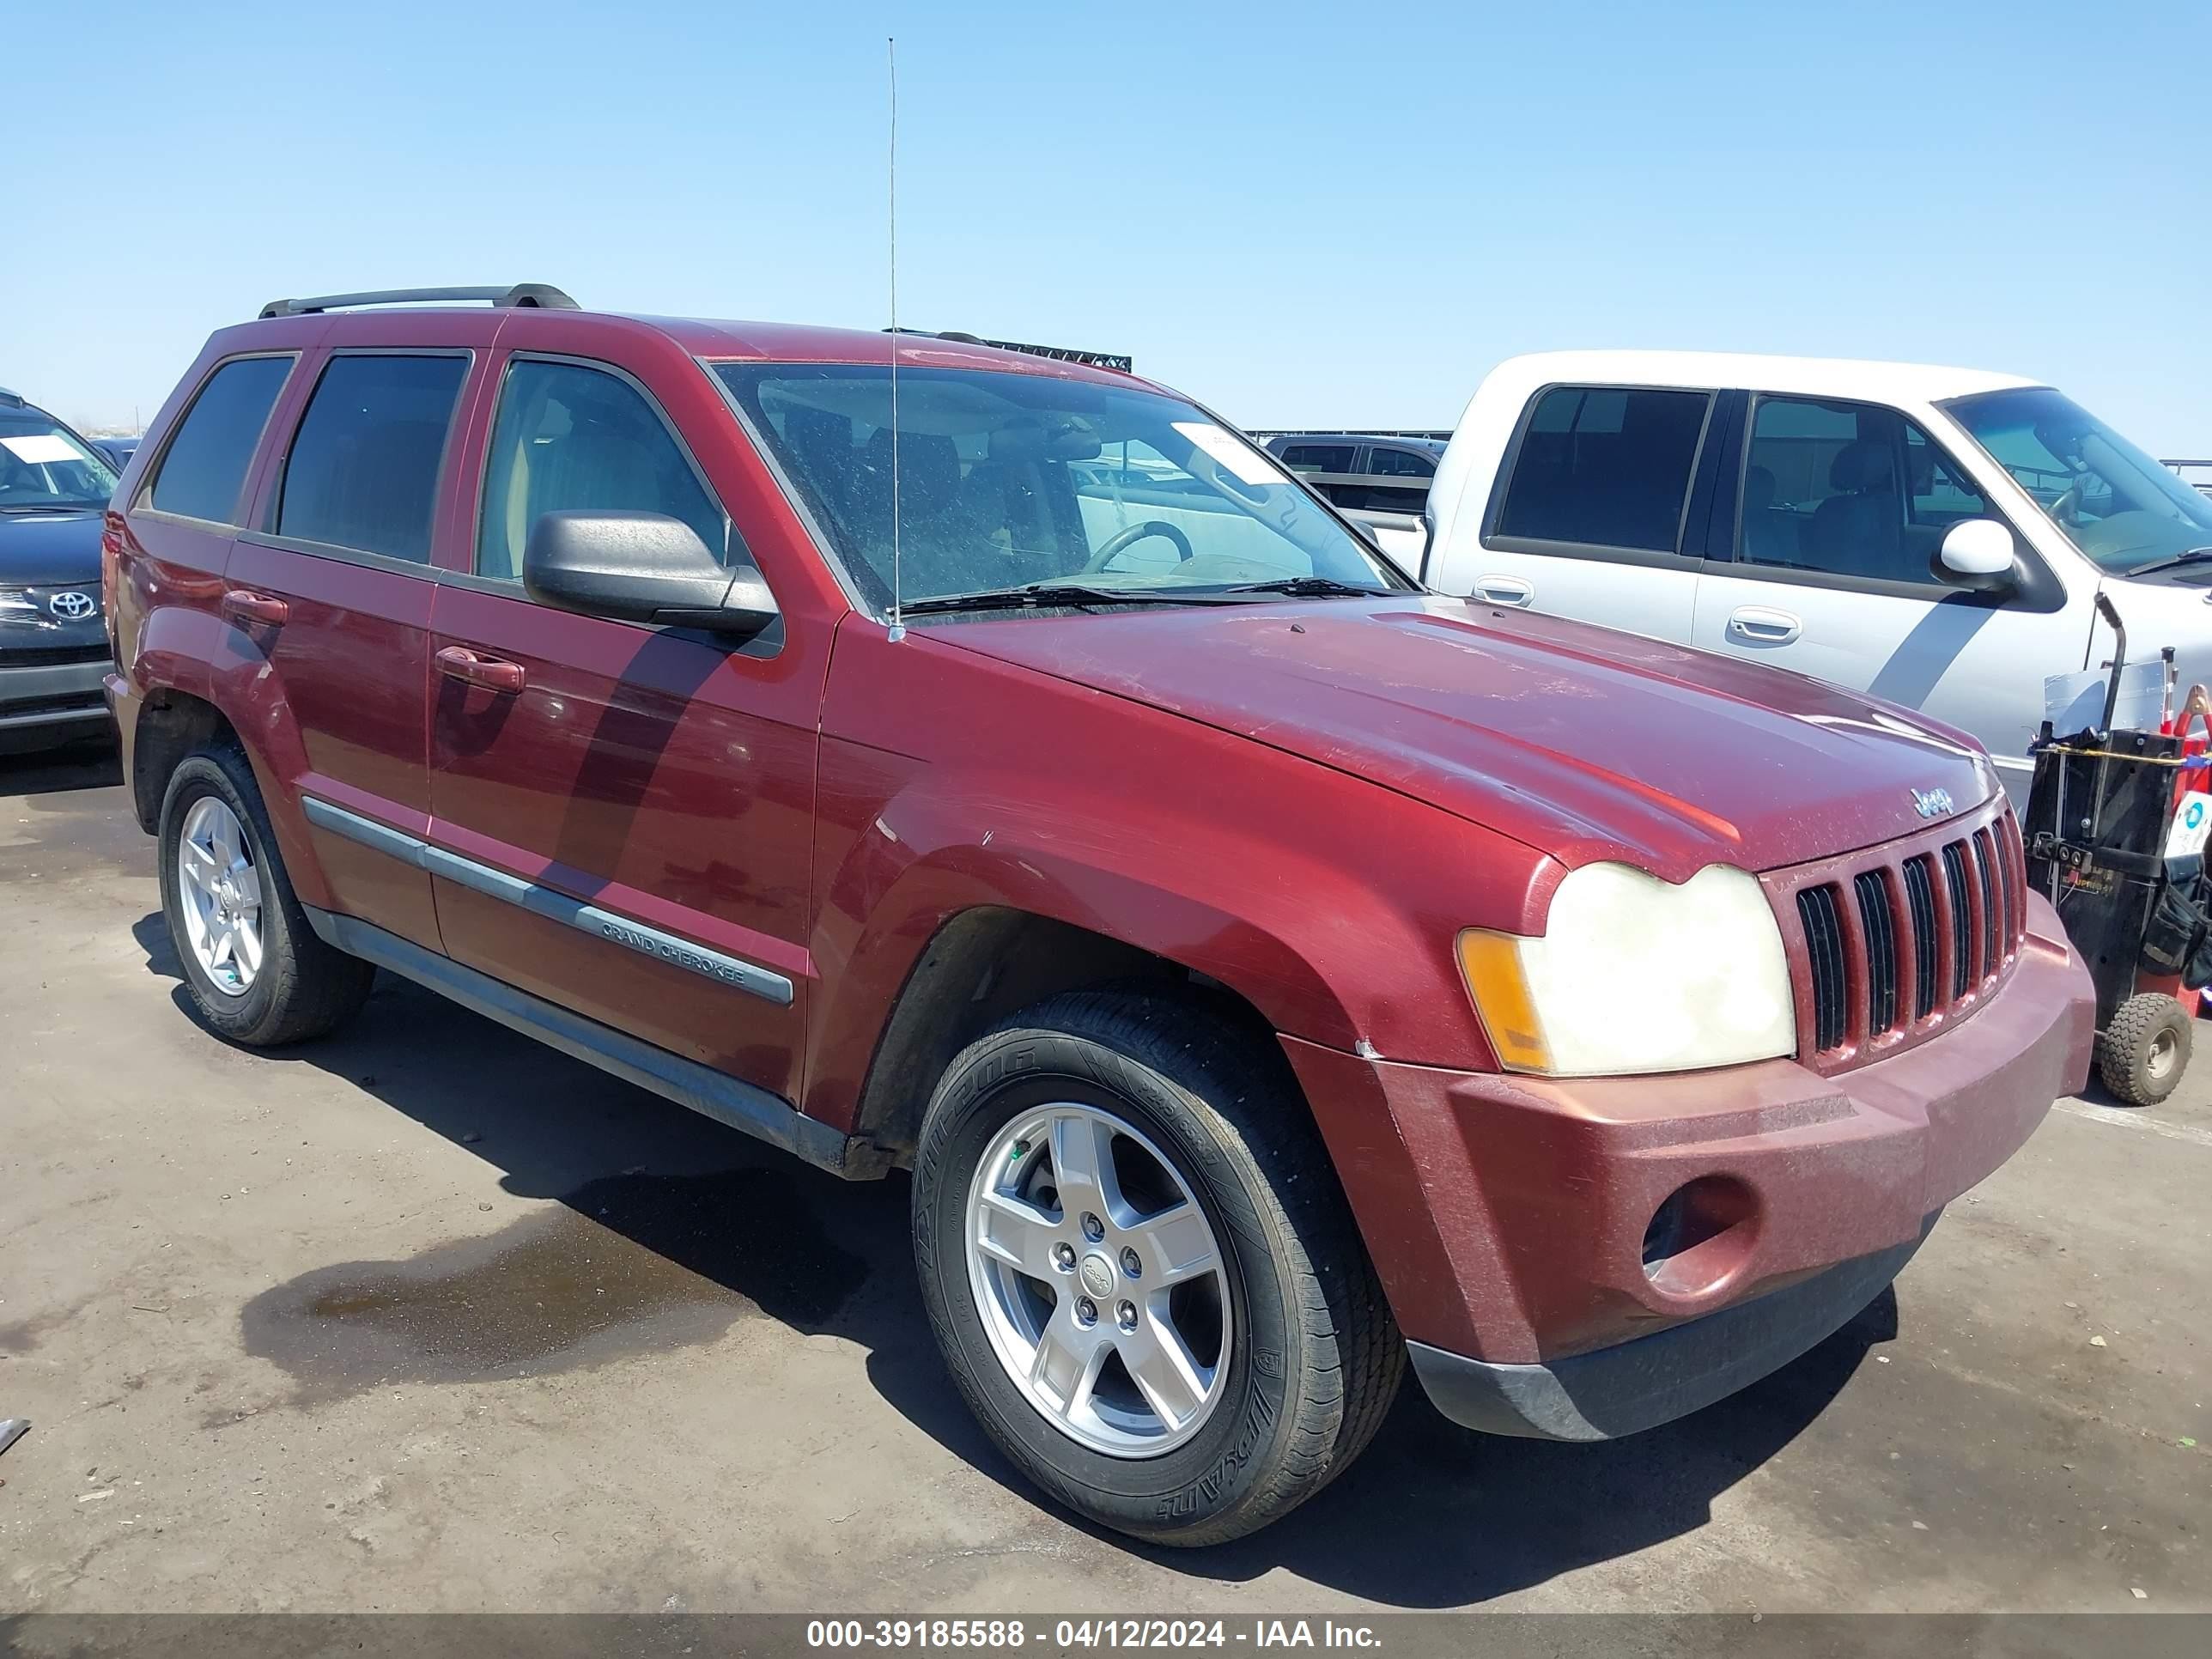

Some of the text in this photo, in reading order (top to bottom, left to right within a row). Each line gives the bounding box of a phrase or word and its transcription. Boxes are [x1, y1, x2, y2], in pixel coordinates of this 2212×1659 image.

[1911, 787, 1954, 818] Jeep
[602, 922, 746, 984] GRAND CHEROKEE
[1085, 1263, 1109, 1290] Jeep
